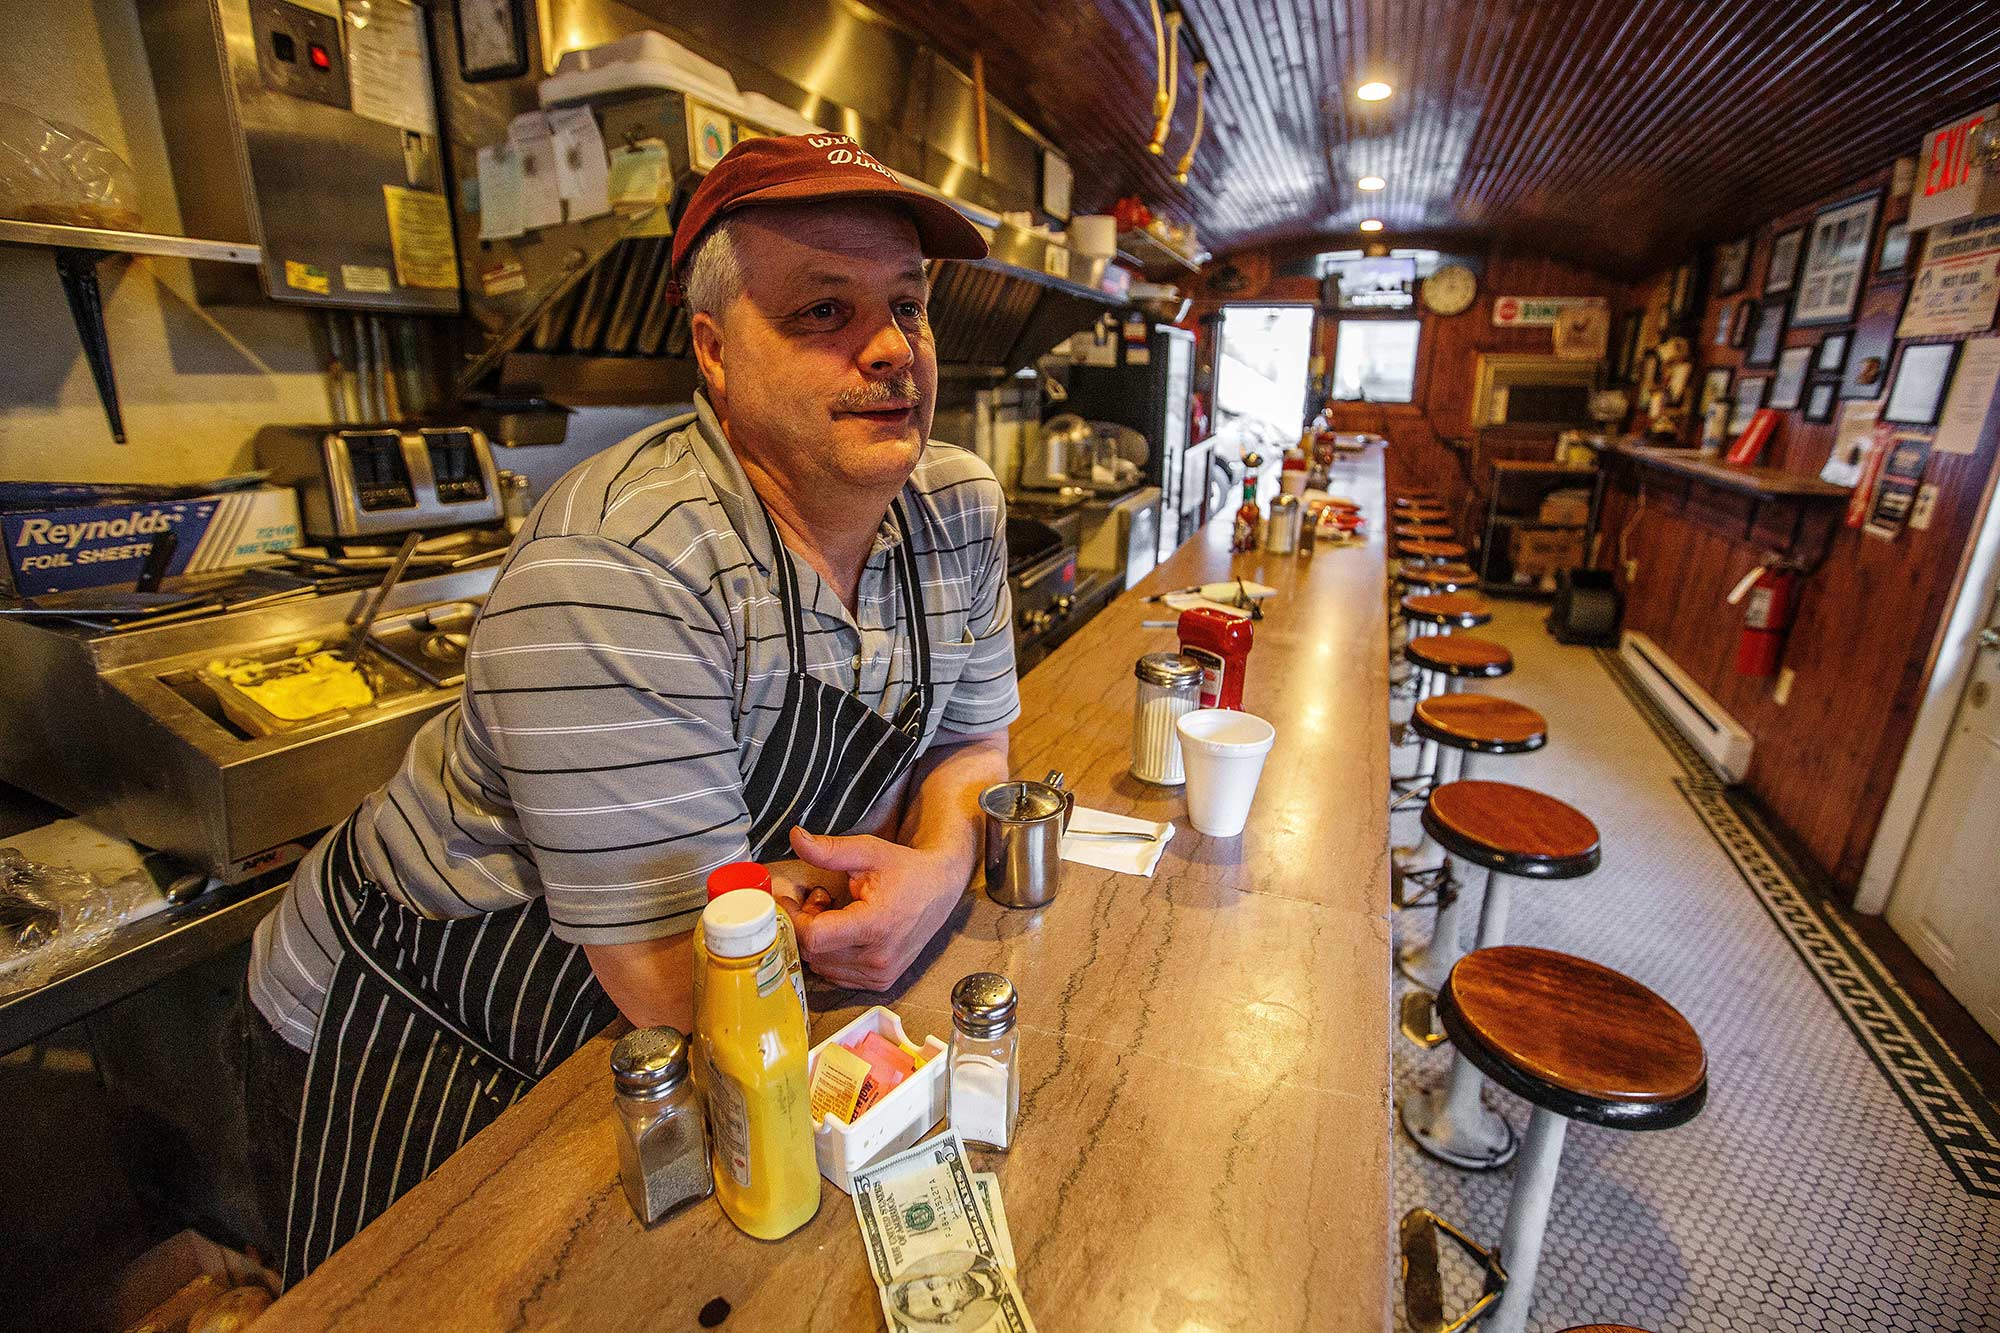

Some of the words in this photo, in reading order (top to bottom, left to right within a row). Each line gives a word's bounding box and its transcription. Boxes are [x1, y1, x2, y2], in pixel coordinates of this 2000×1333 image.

[1924, 115, 1985, 196] EXIT
[16, 510, 171, 548] Reynolds
[20, 553, 73, 573] FOIL
[873, 1181, 886, 1216] STATES
[887, 1191, 903, 1233] AMERICA
[954, 1170, 990, 1255] DOLLARS
[882, 1215, 898, 1246] UNITED
[897, 1231, 908, 1246] OF
[891, 1245, 904, 1266] THE
